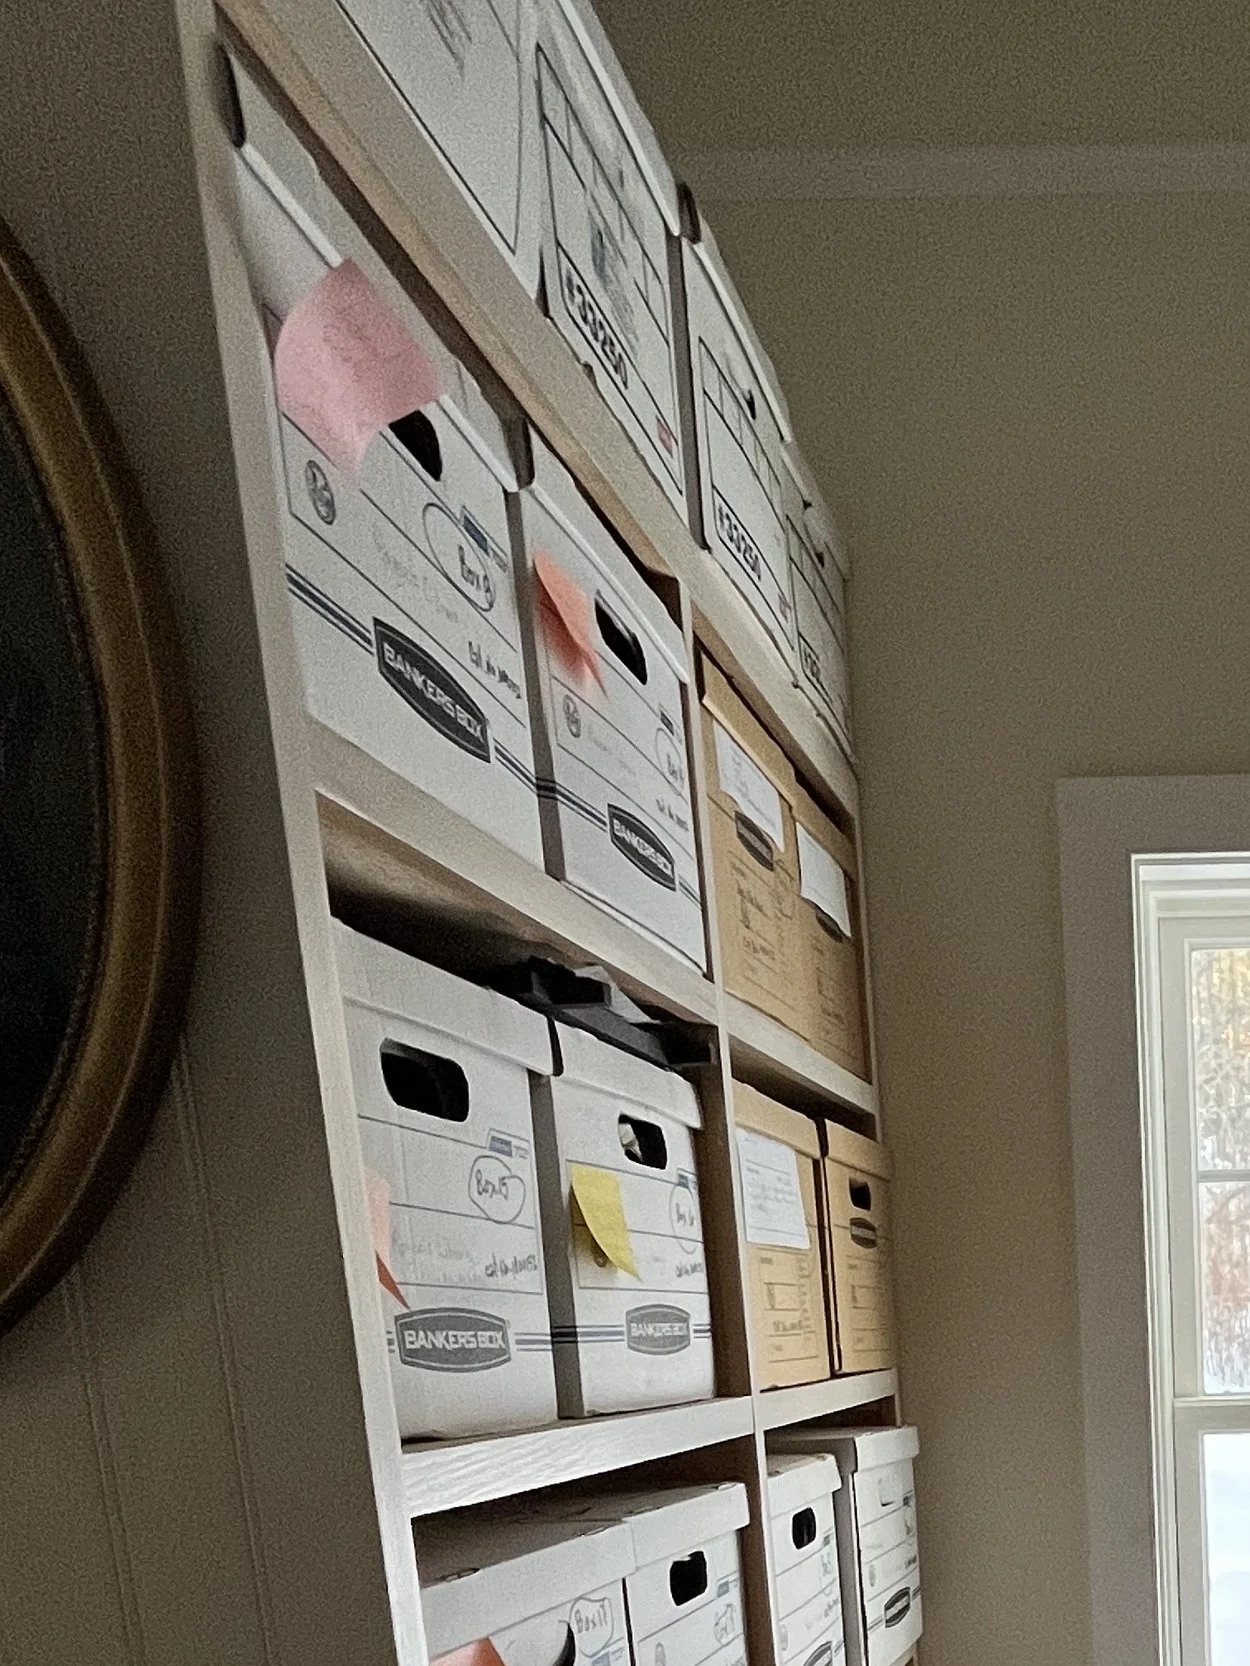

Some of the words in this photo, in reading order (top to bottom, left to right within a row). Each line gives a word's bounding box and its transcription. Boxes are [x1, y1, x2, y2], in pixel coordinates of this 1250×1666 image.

[382, 641, 457, 717] BANKERS
[454, 698, 486, 744] BOX
[403, 1329, 477, 1350] BANKERS
[476, 1330, 506, 1349] BOX
